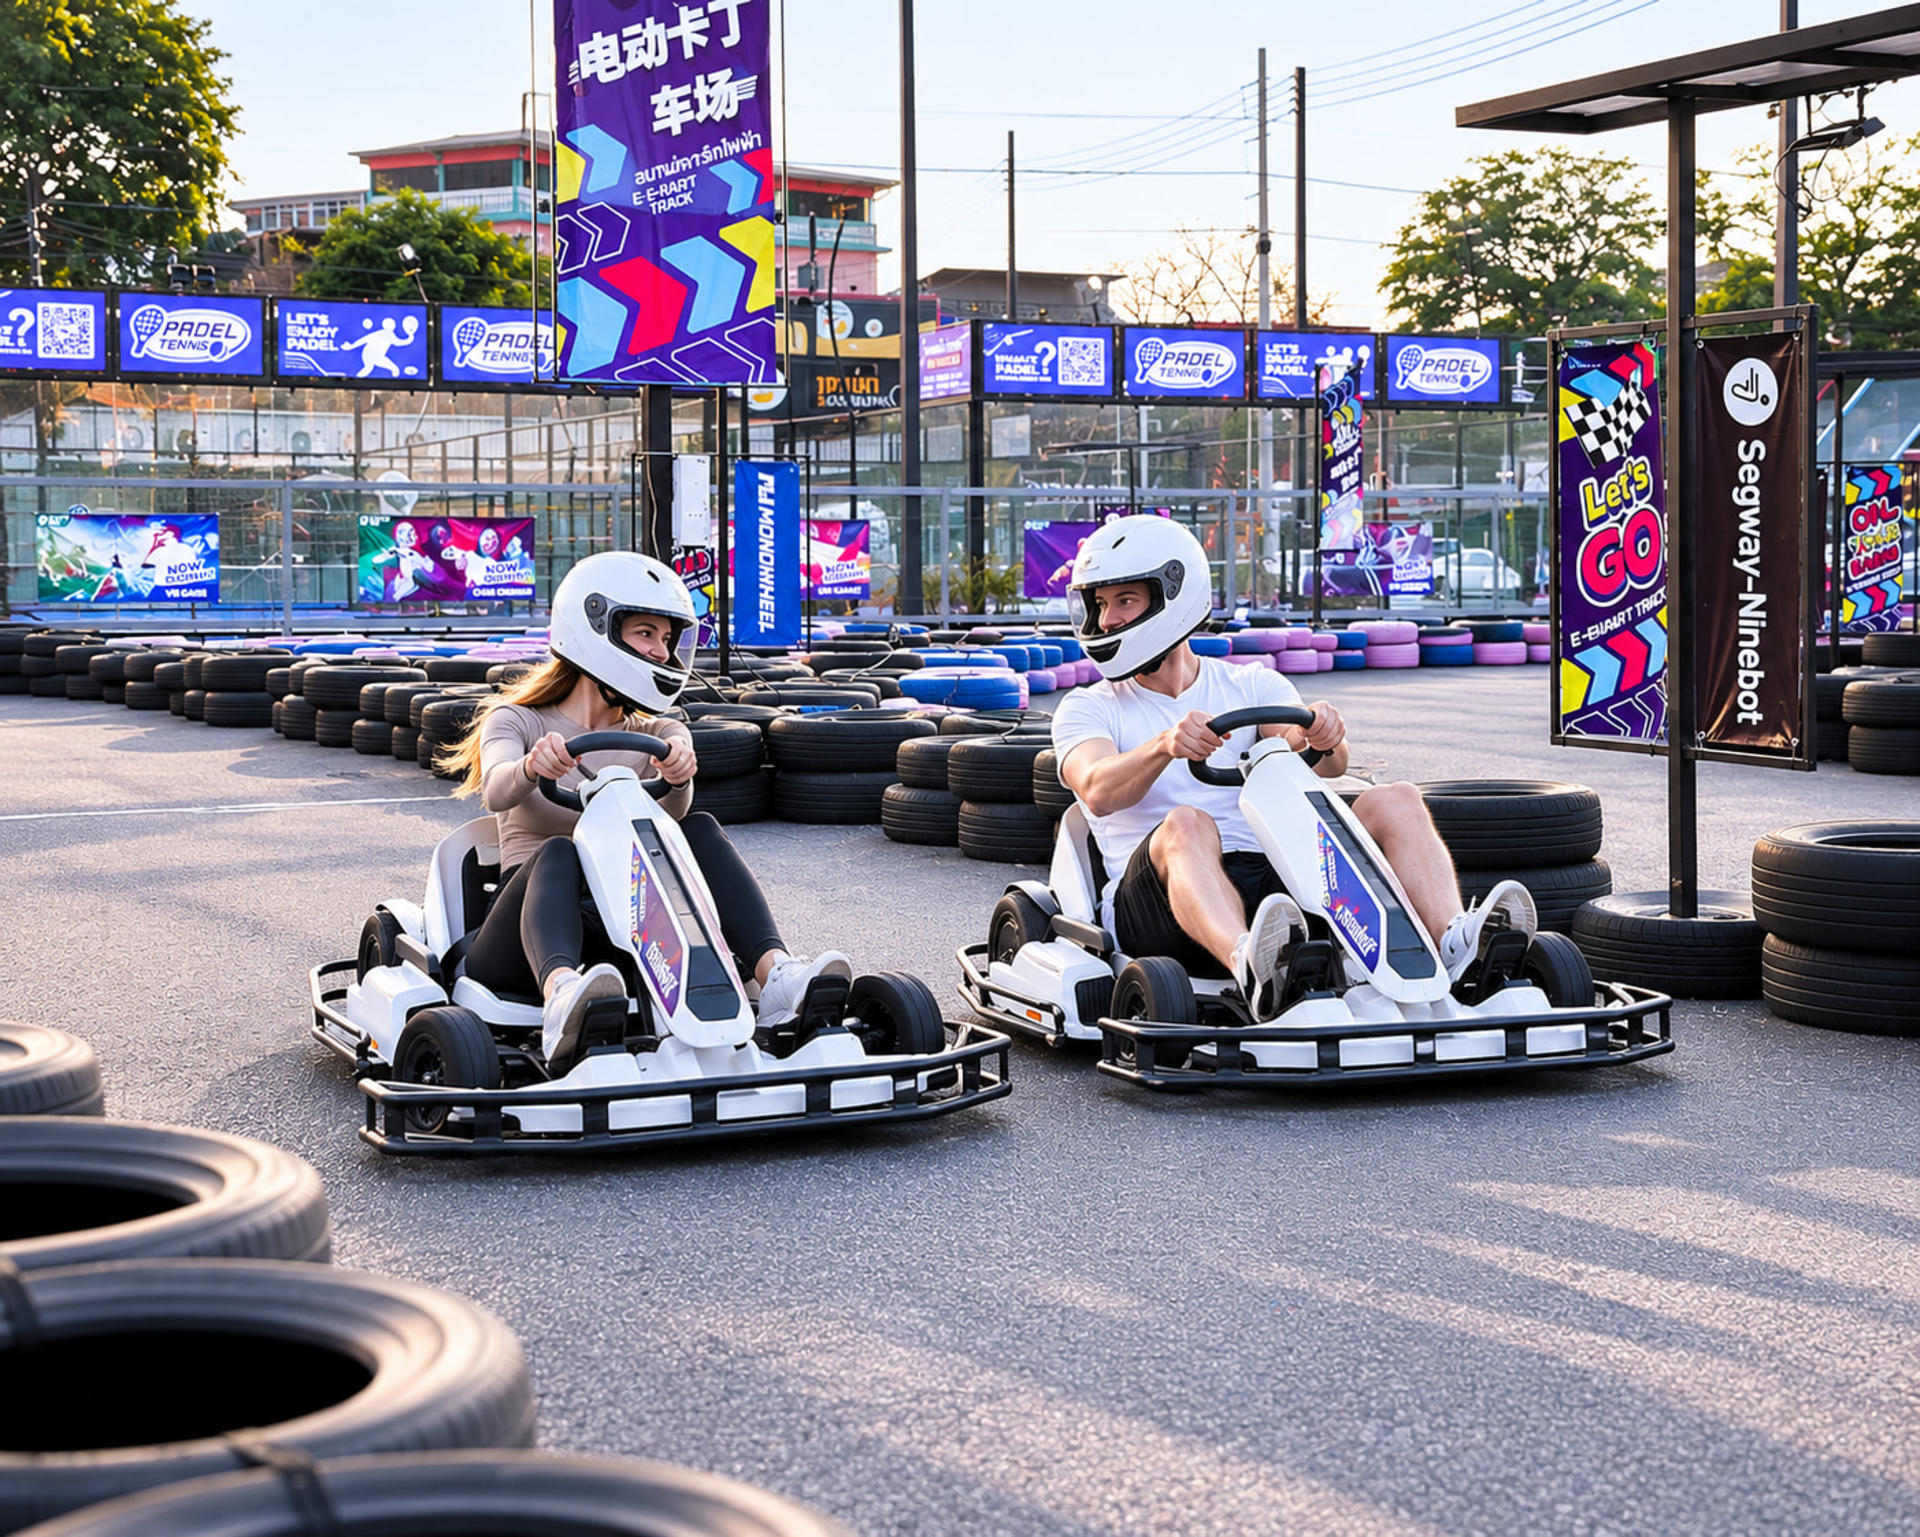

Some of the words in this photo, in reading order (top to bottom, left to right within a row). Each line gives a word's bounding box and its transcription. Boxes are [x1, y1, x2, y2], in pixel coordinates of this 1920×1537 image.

[650, 68, 742, 137] 车场
[649, 191, 694, 215] TRACK
[286, 313, 329, 325] LET'S
[162, 321, 238, 339] PADEL
[160, 339, 209, 351] TENNIS
[286, 338, 339, 351] PADEL
[1162, 352, 1225, 367] PADEL
[1421, 358, 1481, 373] PADEL
[1583, 460, 1651, 526] Let's
[1578, 505, 1662, 602] GO
[167, 561, 202, 574] NOW
[486, 562, 518, 574] NOW
[1732, 439, 1768, 725] Segway-Ninebot
